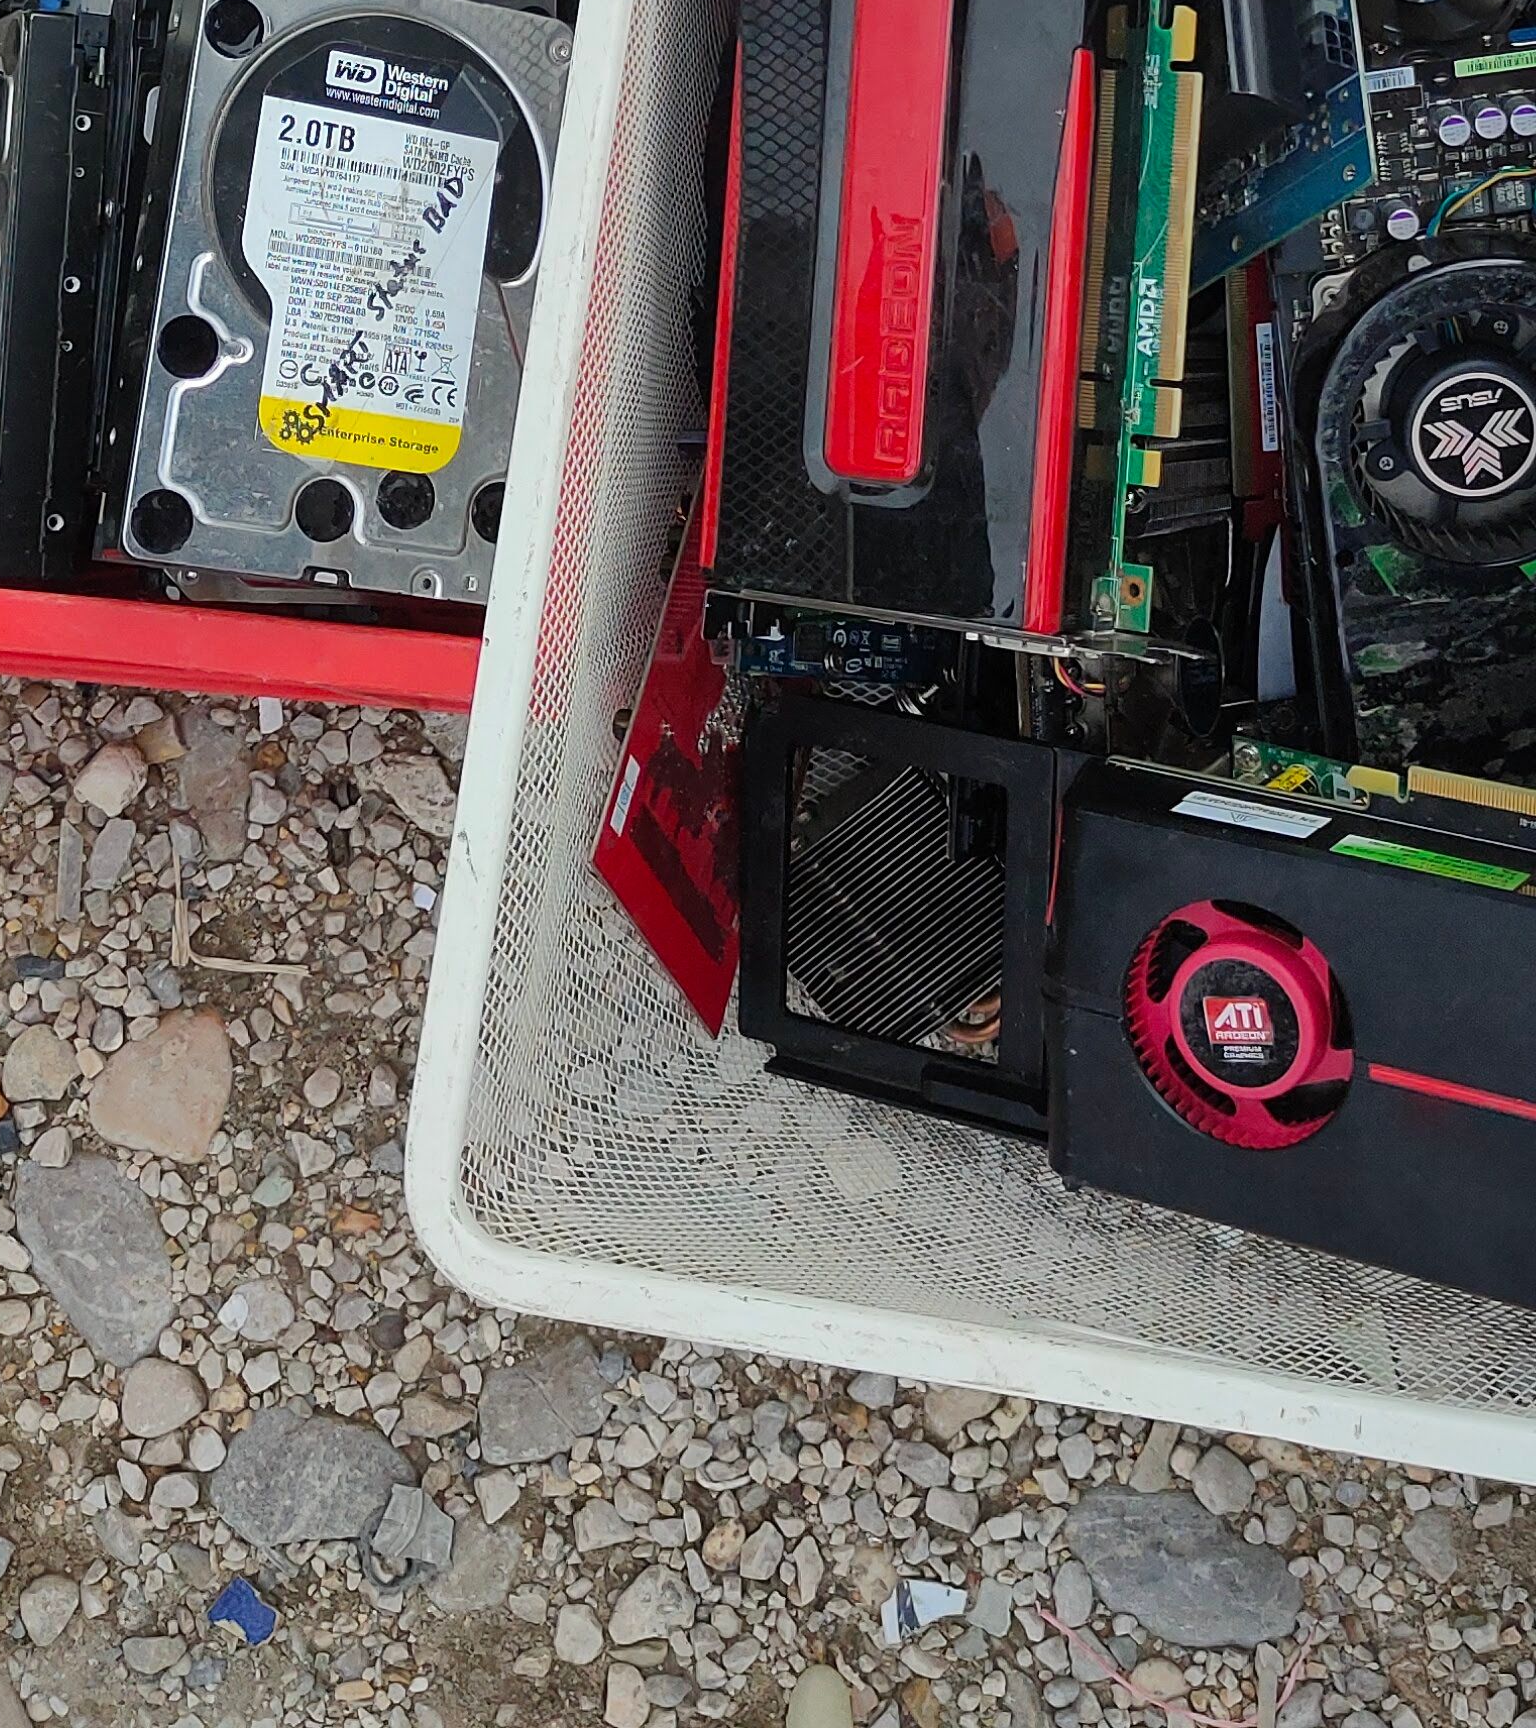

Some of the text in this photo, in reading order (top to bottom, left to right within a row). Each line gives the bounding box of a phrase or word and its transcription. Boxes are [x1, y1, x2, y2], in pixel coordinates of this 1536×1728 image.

[334, 58, 377, 84] WD
[385, 64, 449, 91] Western
[324, 87, 440, 120] www.westerndigital.com
[383, 80, 433, 105] Digital
[277, 113, 357, 154] 2.0TB
[404, 133, 418, 146] WD
[402, 144, 422, 157] SATA
[401, 155, 475, 181] WD2002FYPS
[418, 169, 470, 234] BAD
[874, 213, 922, 461] RADEON
[1135, 294, 1157, 355] AMD
[384, 355, 408, 376] ATA
[383, 380, 394, 391] 20
[432, 385, 457, 407] CE
[1438, 387, 1504, 412] ASUS
[319, 425, 439, 456] Enterprise Storage
[1213, 999, 1265, 1033] ATI
[1214, 1029, 1267, 1043] RADEON
